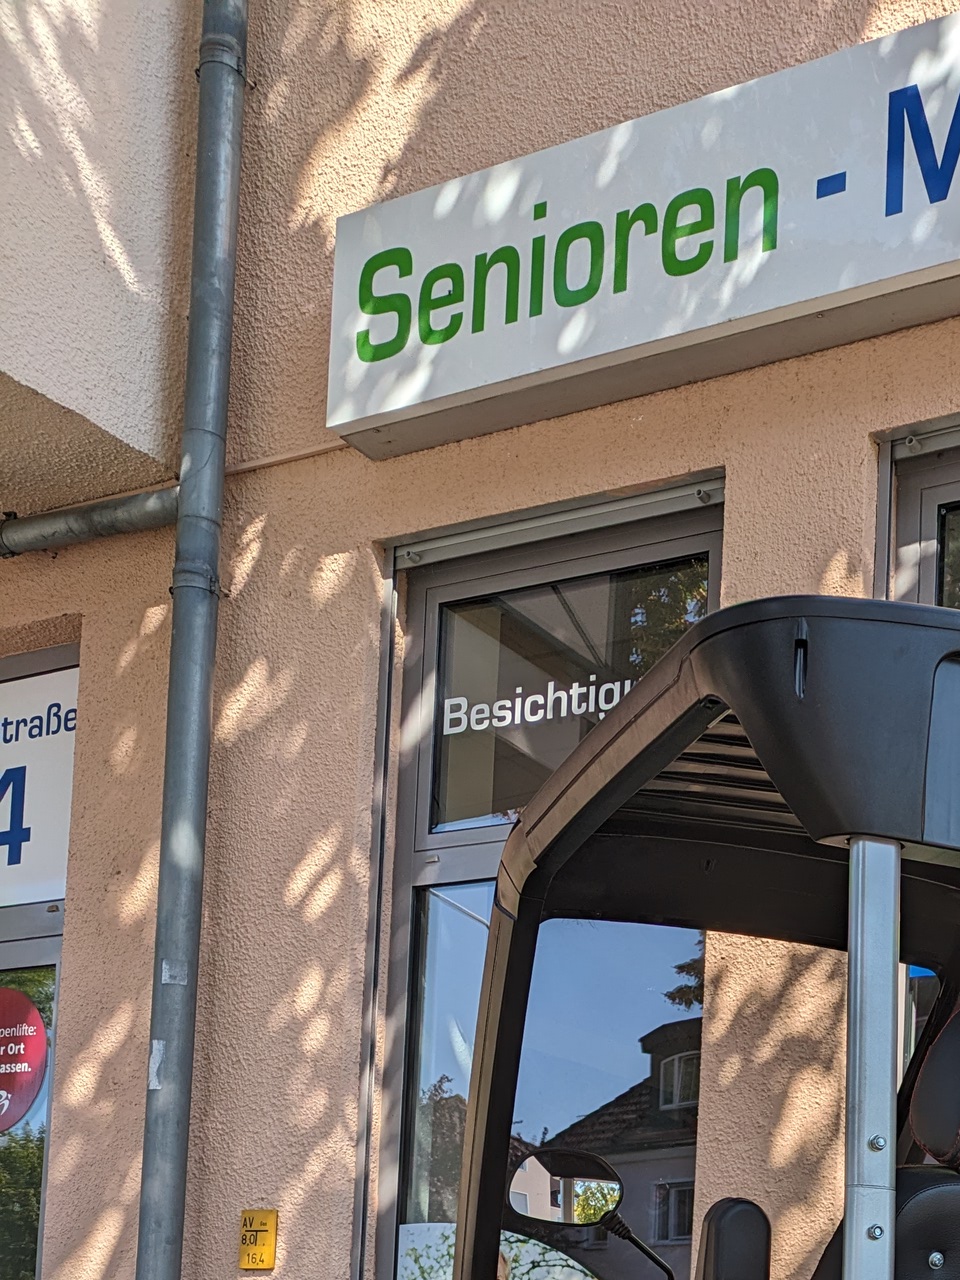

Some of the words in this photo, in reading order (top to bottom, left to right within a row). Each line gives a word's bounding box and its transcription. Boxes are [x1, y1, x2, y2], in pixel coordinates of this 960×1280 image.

[356, 166, 779, 363] Senioren
[7, 1042, 25, 1055] Ort
[242, 1216, 255, 1229] AV
[247, 1252, 265, 1266] 16,4
